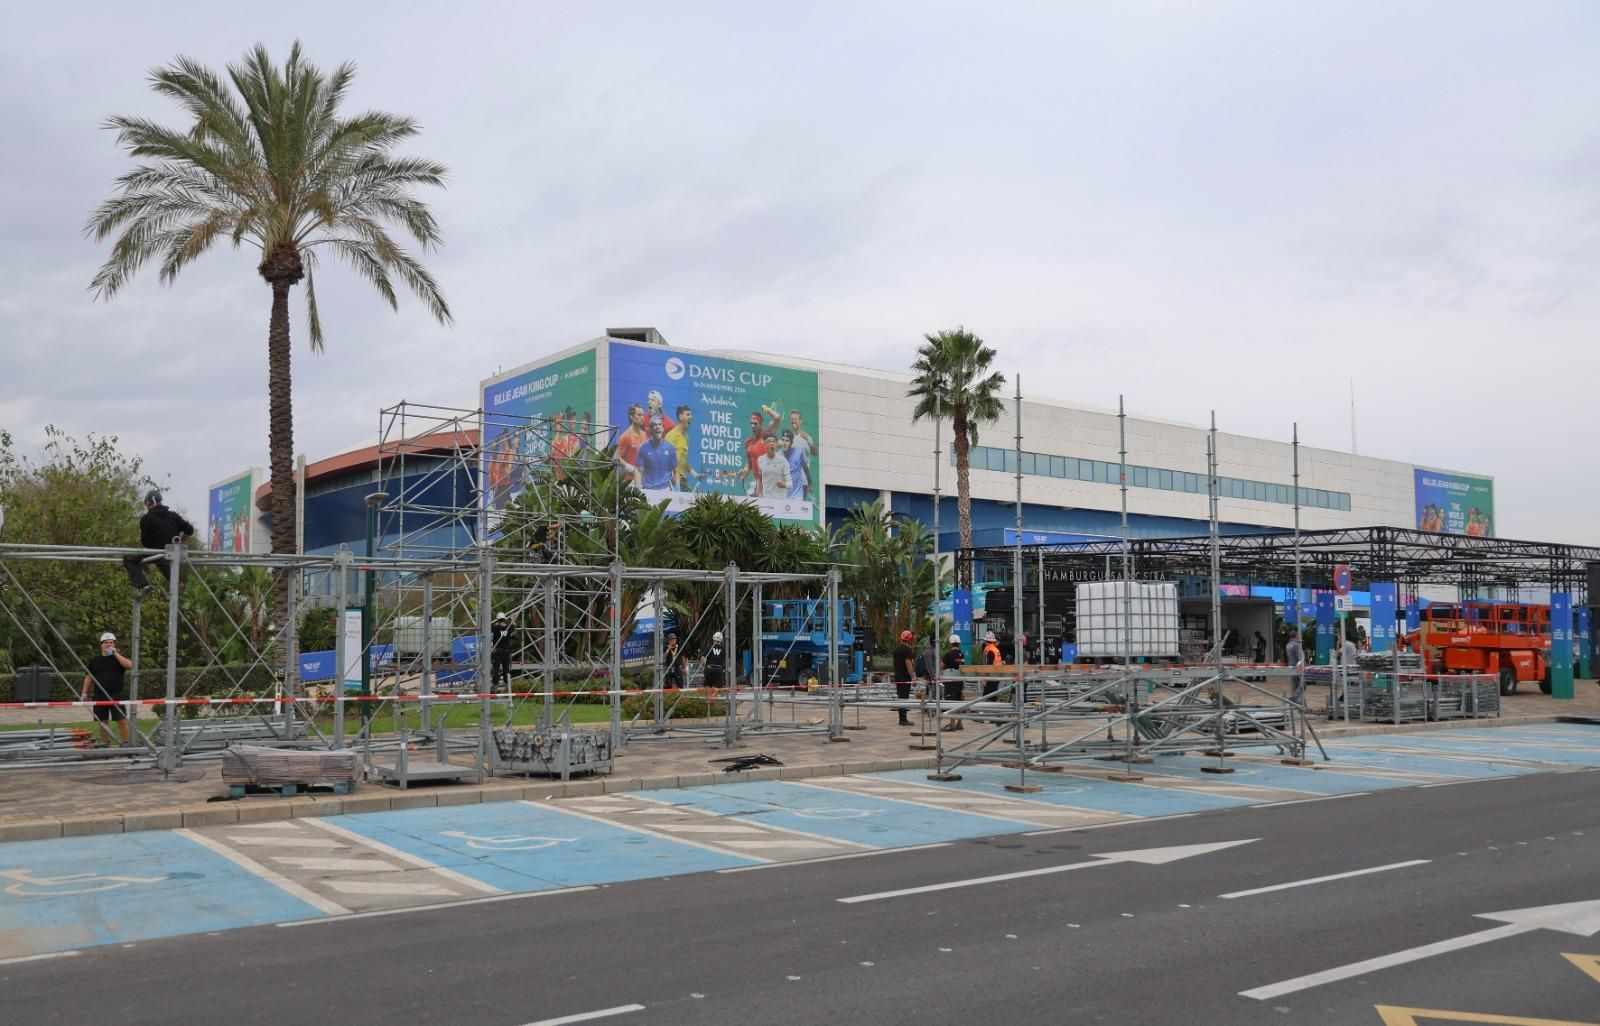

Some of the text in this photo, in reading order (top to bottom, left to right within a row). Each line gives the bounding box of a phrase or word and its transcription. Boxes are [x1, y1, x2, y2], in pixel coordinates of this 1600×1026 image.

[689, 364, 772, 387] DAVIS CUP
[494, 389, 511, 406] BILLIE
[511, 384, 528, 400] JEAN
[528, 379, 545, 394] KING
[544, 374, 559, 388] CUP
[710, 410, 733, 424] THE
[701, 424, 742, 439] WORLD
[701, 438, 741, 452] CUP OF
[700, 452, 742, 466] TENNIS
[712, 648, 721, 656] W
